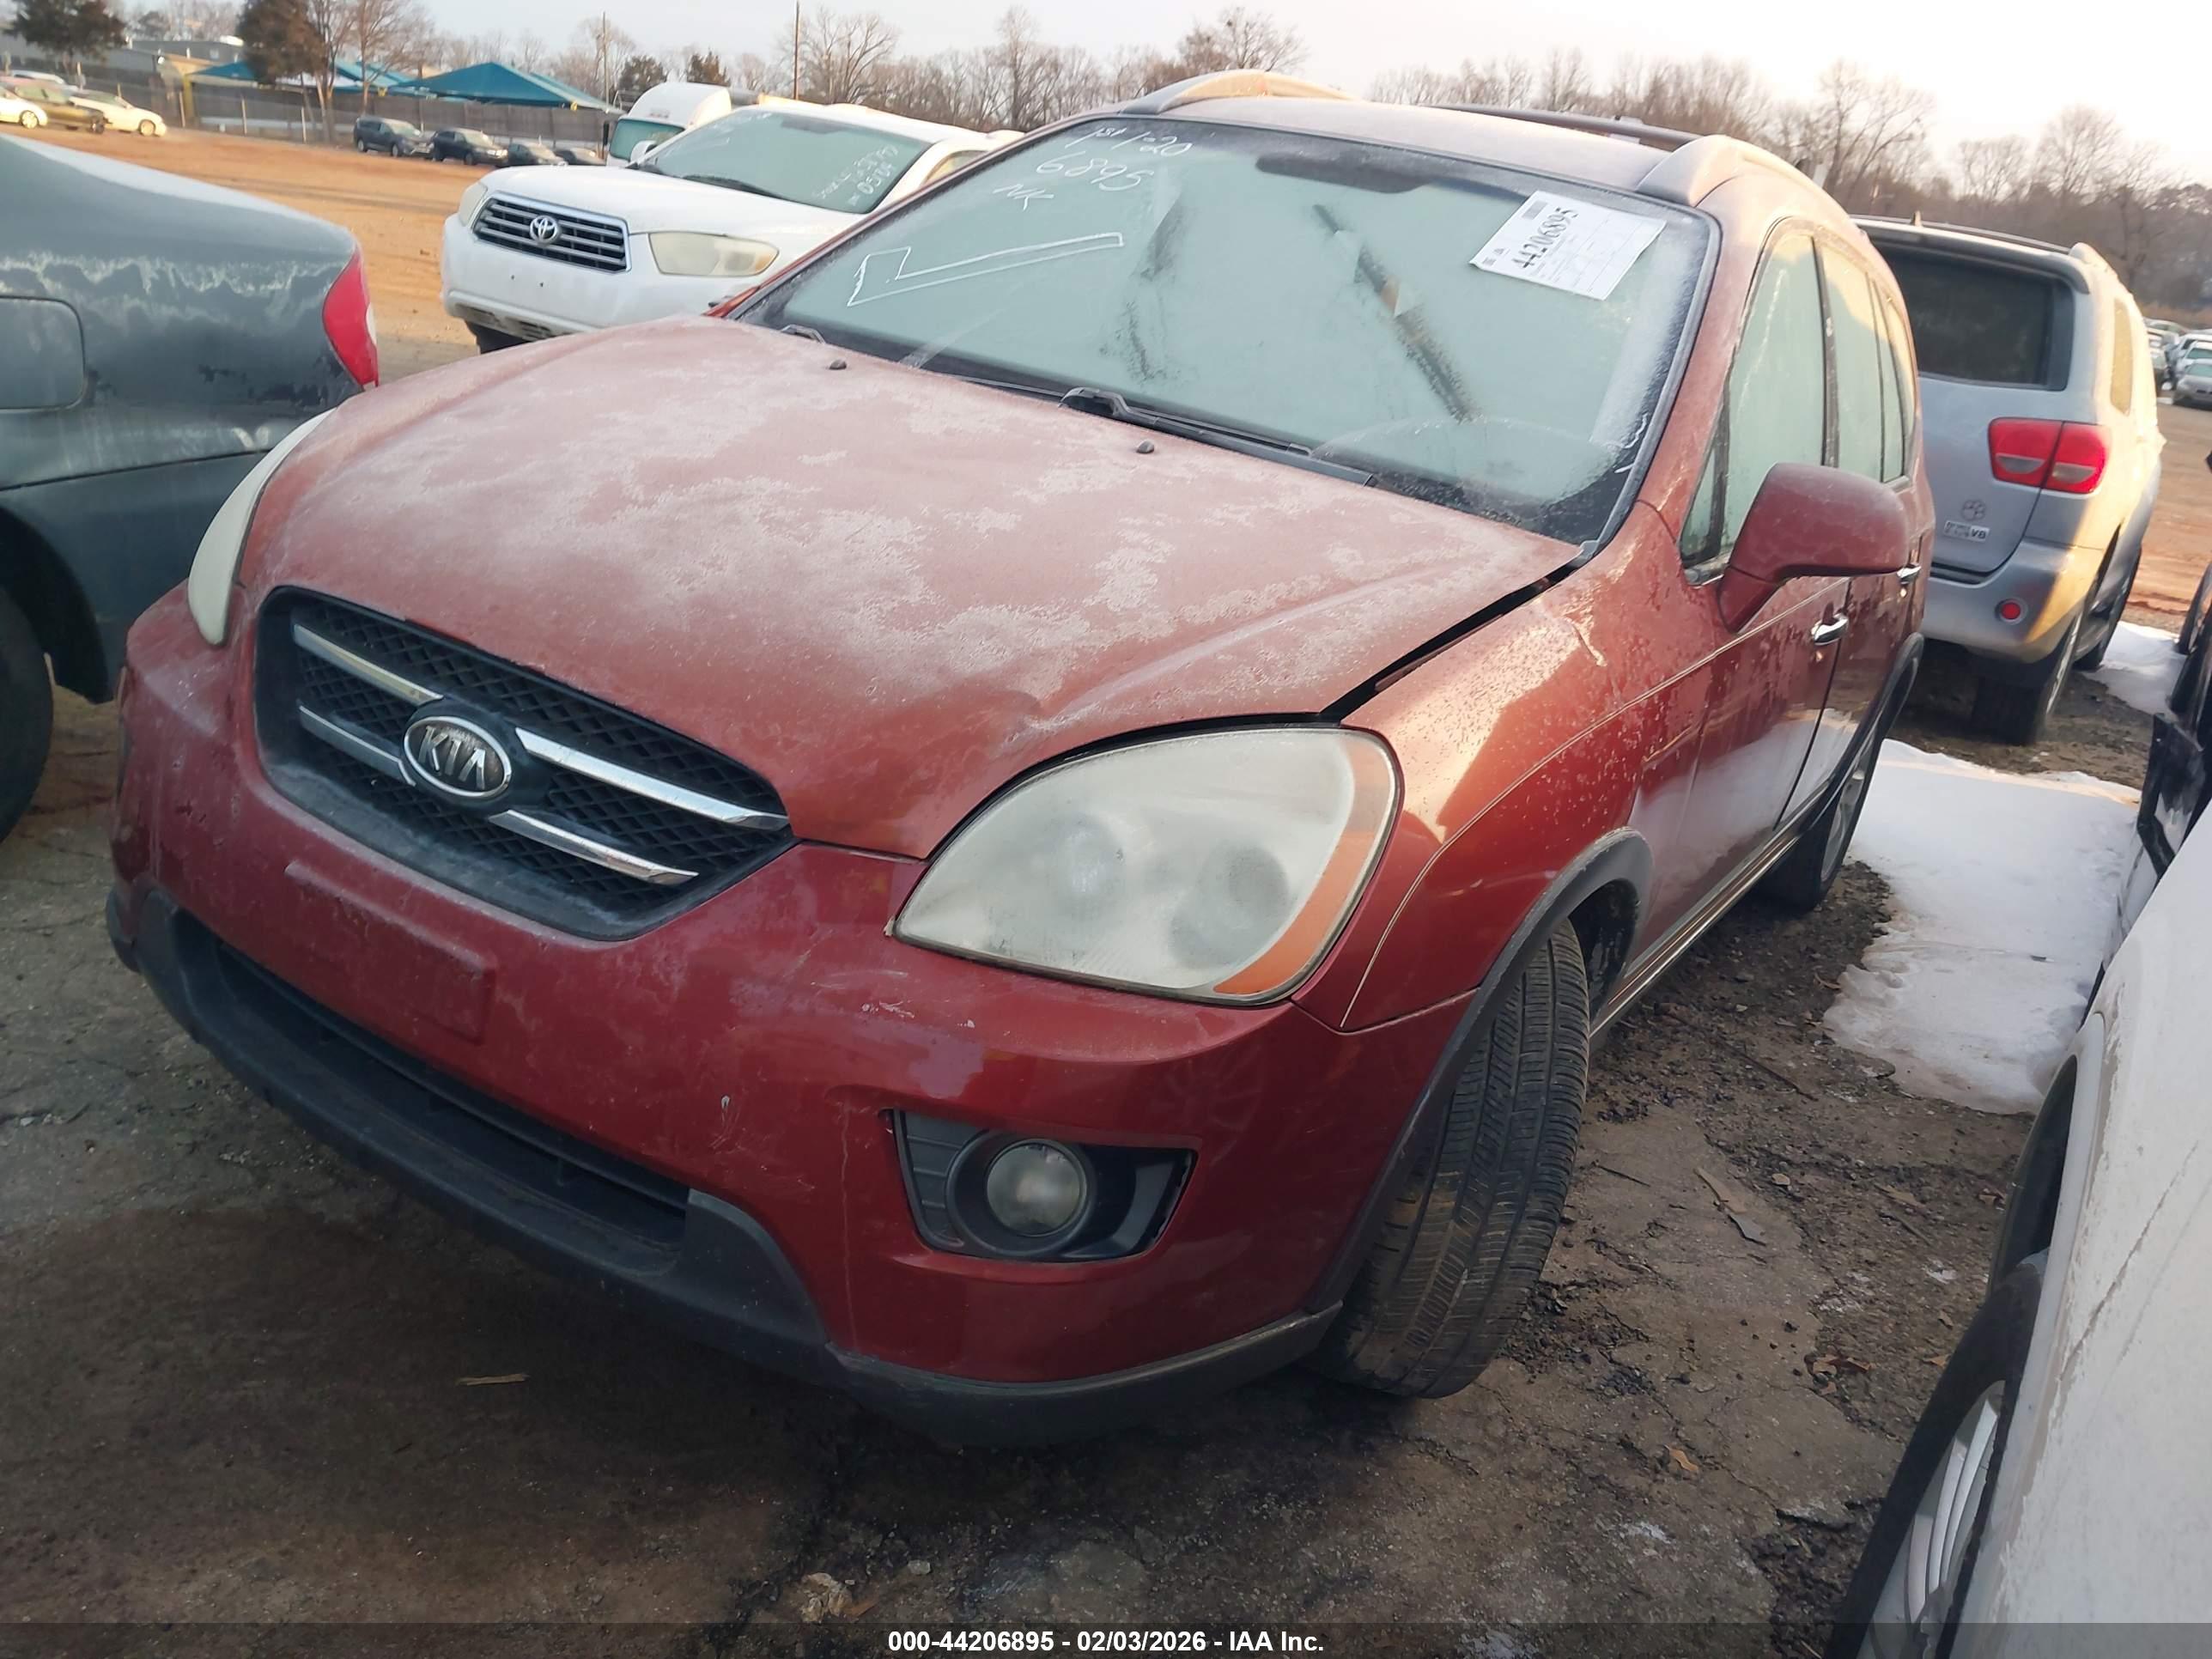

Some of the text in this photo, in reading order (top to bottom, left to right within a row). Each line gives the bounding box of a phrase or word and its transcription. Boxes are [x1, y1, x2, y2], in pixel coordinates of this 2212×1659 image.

[1036, 150, 1155, 191] 6895
[1511, 207, 1579, 269] 44206895
[417, 725, 487, 790] KIA
